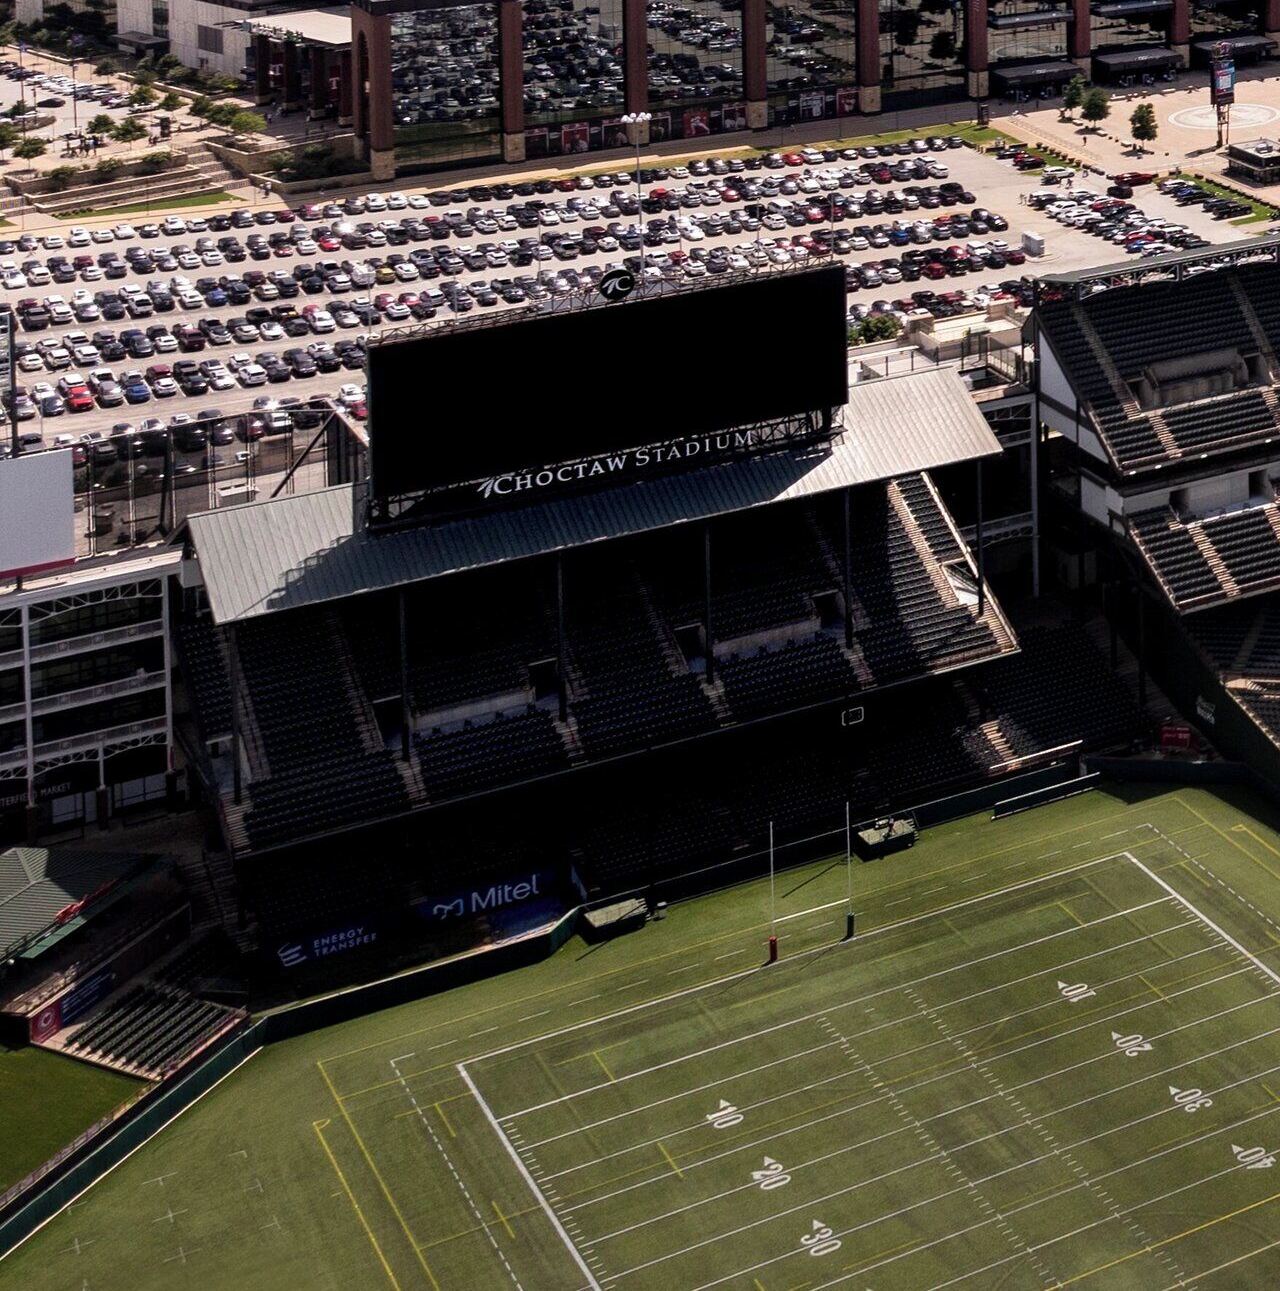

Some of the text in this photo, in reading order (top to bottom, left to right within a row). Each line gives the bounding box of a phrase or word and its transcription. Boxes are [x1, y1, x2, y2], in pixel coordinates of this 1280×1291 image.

[493, 430, 753, 495] CHOCTAW STADIUM
[40, 782, 71, 796] MARKET
[471, 874, 540, 912] Mitel
[313, 926, 364, 948] ENERGY
[1061, 983, 1096, 1002] 10
[1116, 1034, 1153, 1057] 20
[1174, 1088, 1213, 1113] 30
[706, 1106, 744, 1129] 10
[1237, 1147, 1276, 1169] 40
[751, 1163, 791, 1190] 20
[801, 1228, 842, 1257] 30
